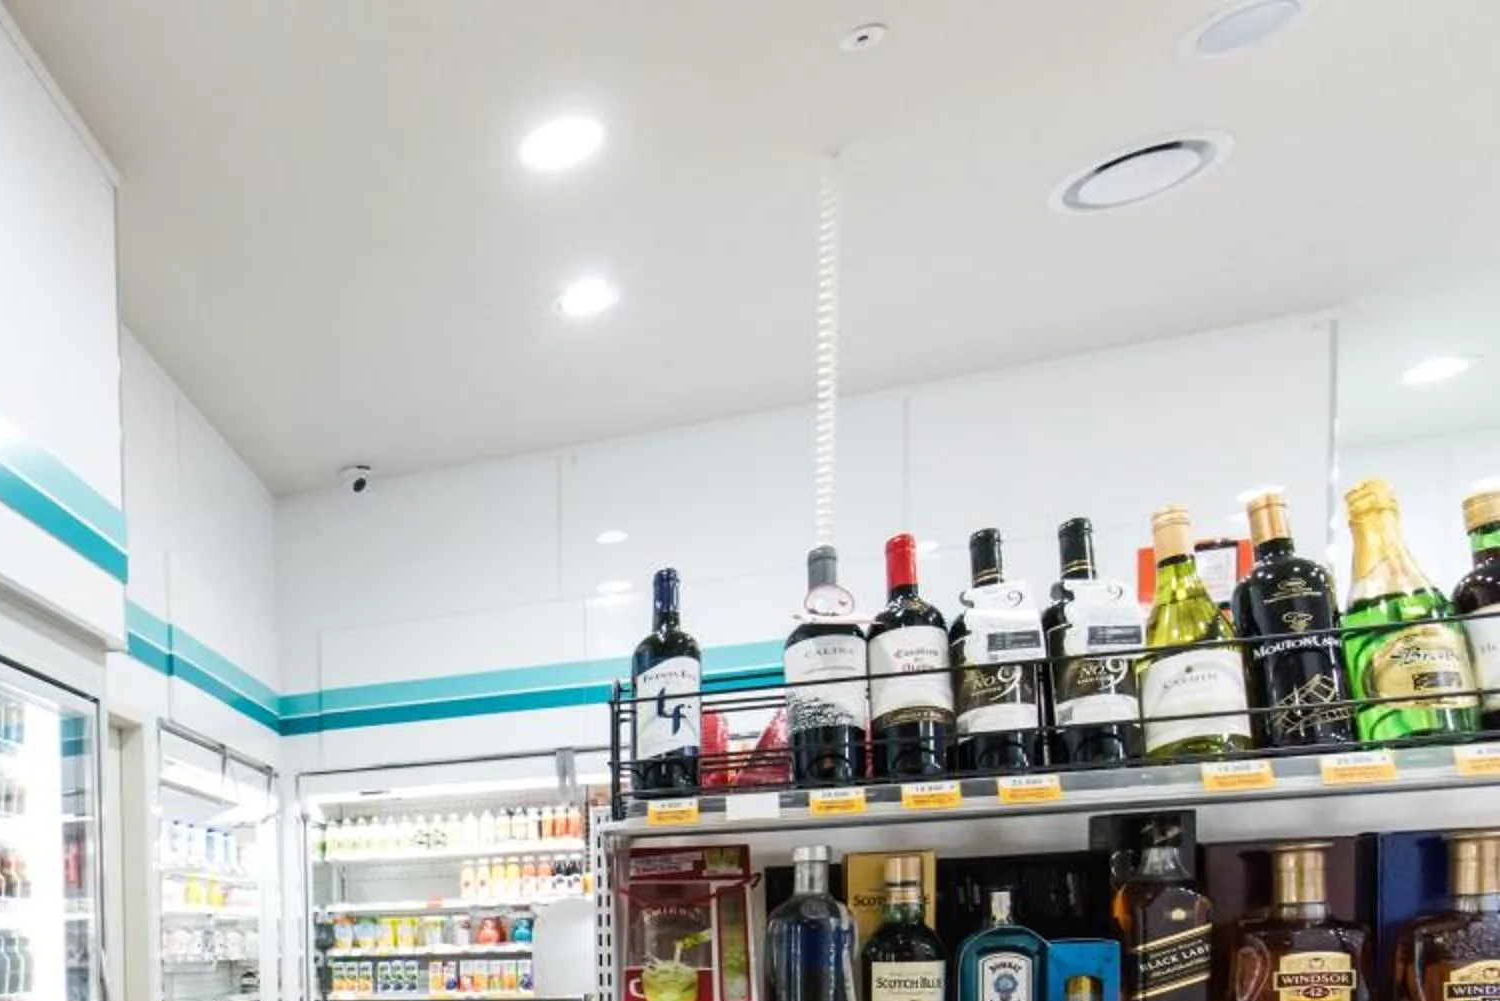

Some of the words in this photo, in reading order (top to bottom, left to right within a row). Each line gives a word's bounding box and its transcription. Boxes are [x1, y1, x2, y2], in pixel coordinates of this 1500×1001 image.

[875, 976, 919, 990] SCOTCH
[1281, 972, 1350, 985] WINDSOR
[1452, 984, 1500, 997] WINDS
